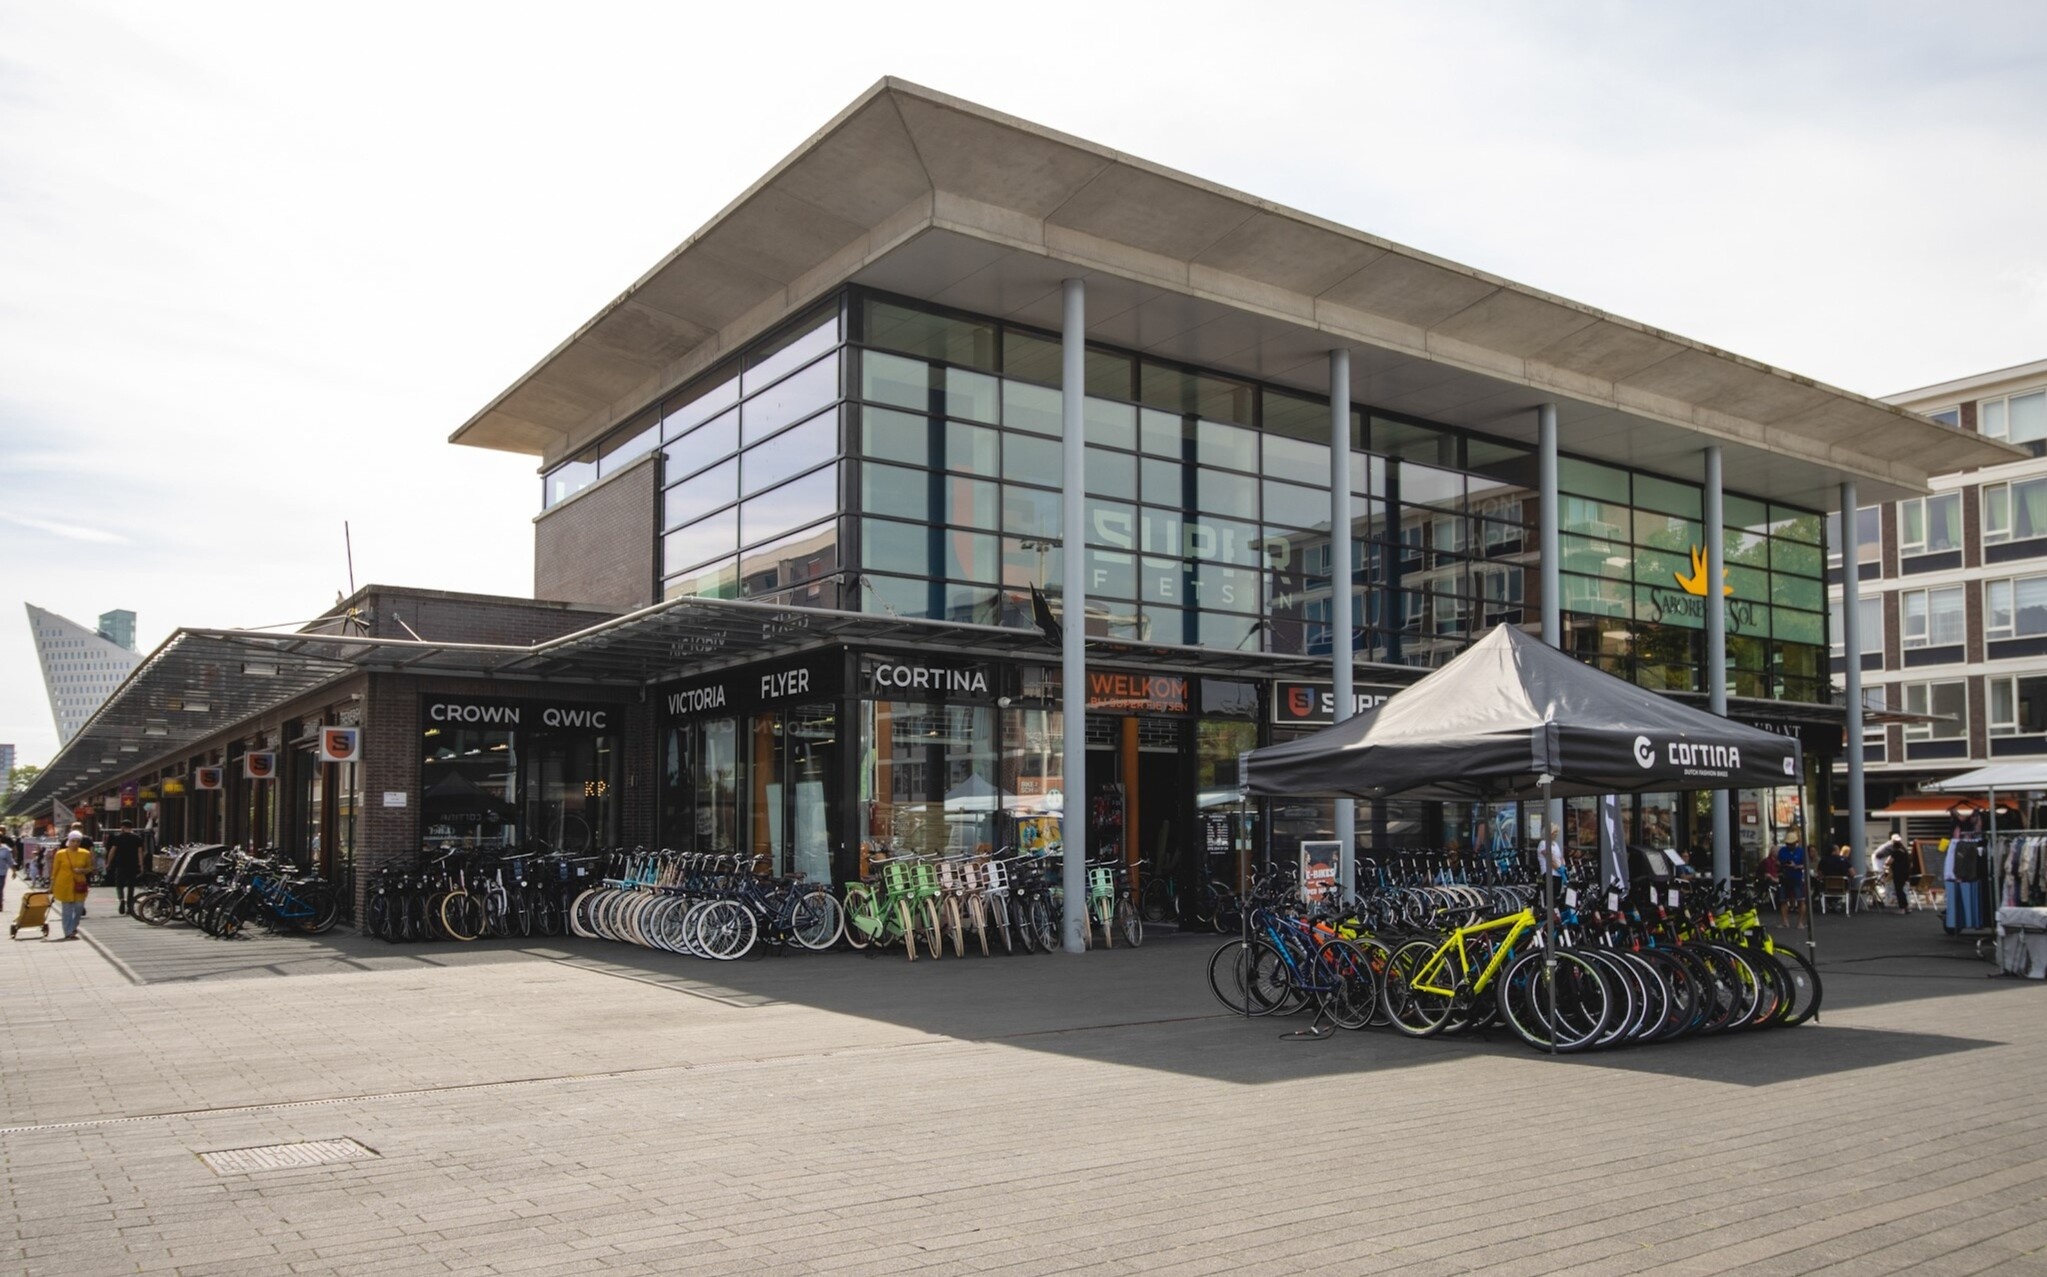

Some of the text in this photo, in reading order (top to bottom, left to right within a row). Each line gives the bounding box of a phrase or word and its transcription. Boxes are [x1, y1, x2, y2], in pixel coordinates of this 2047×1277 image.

[761, 668, 809, 699] FLYER
[876, 663, 988, 693] CORTINA
[1090, 673, 1188, 699] WELKOM
[668, 684, 726, 715] VICTORIA
[430, 703, 607, 729] CROWN QWIC
